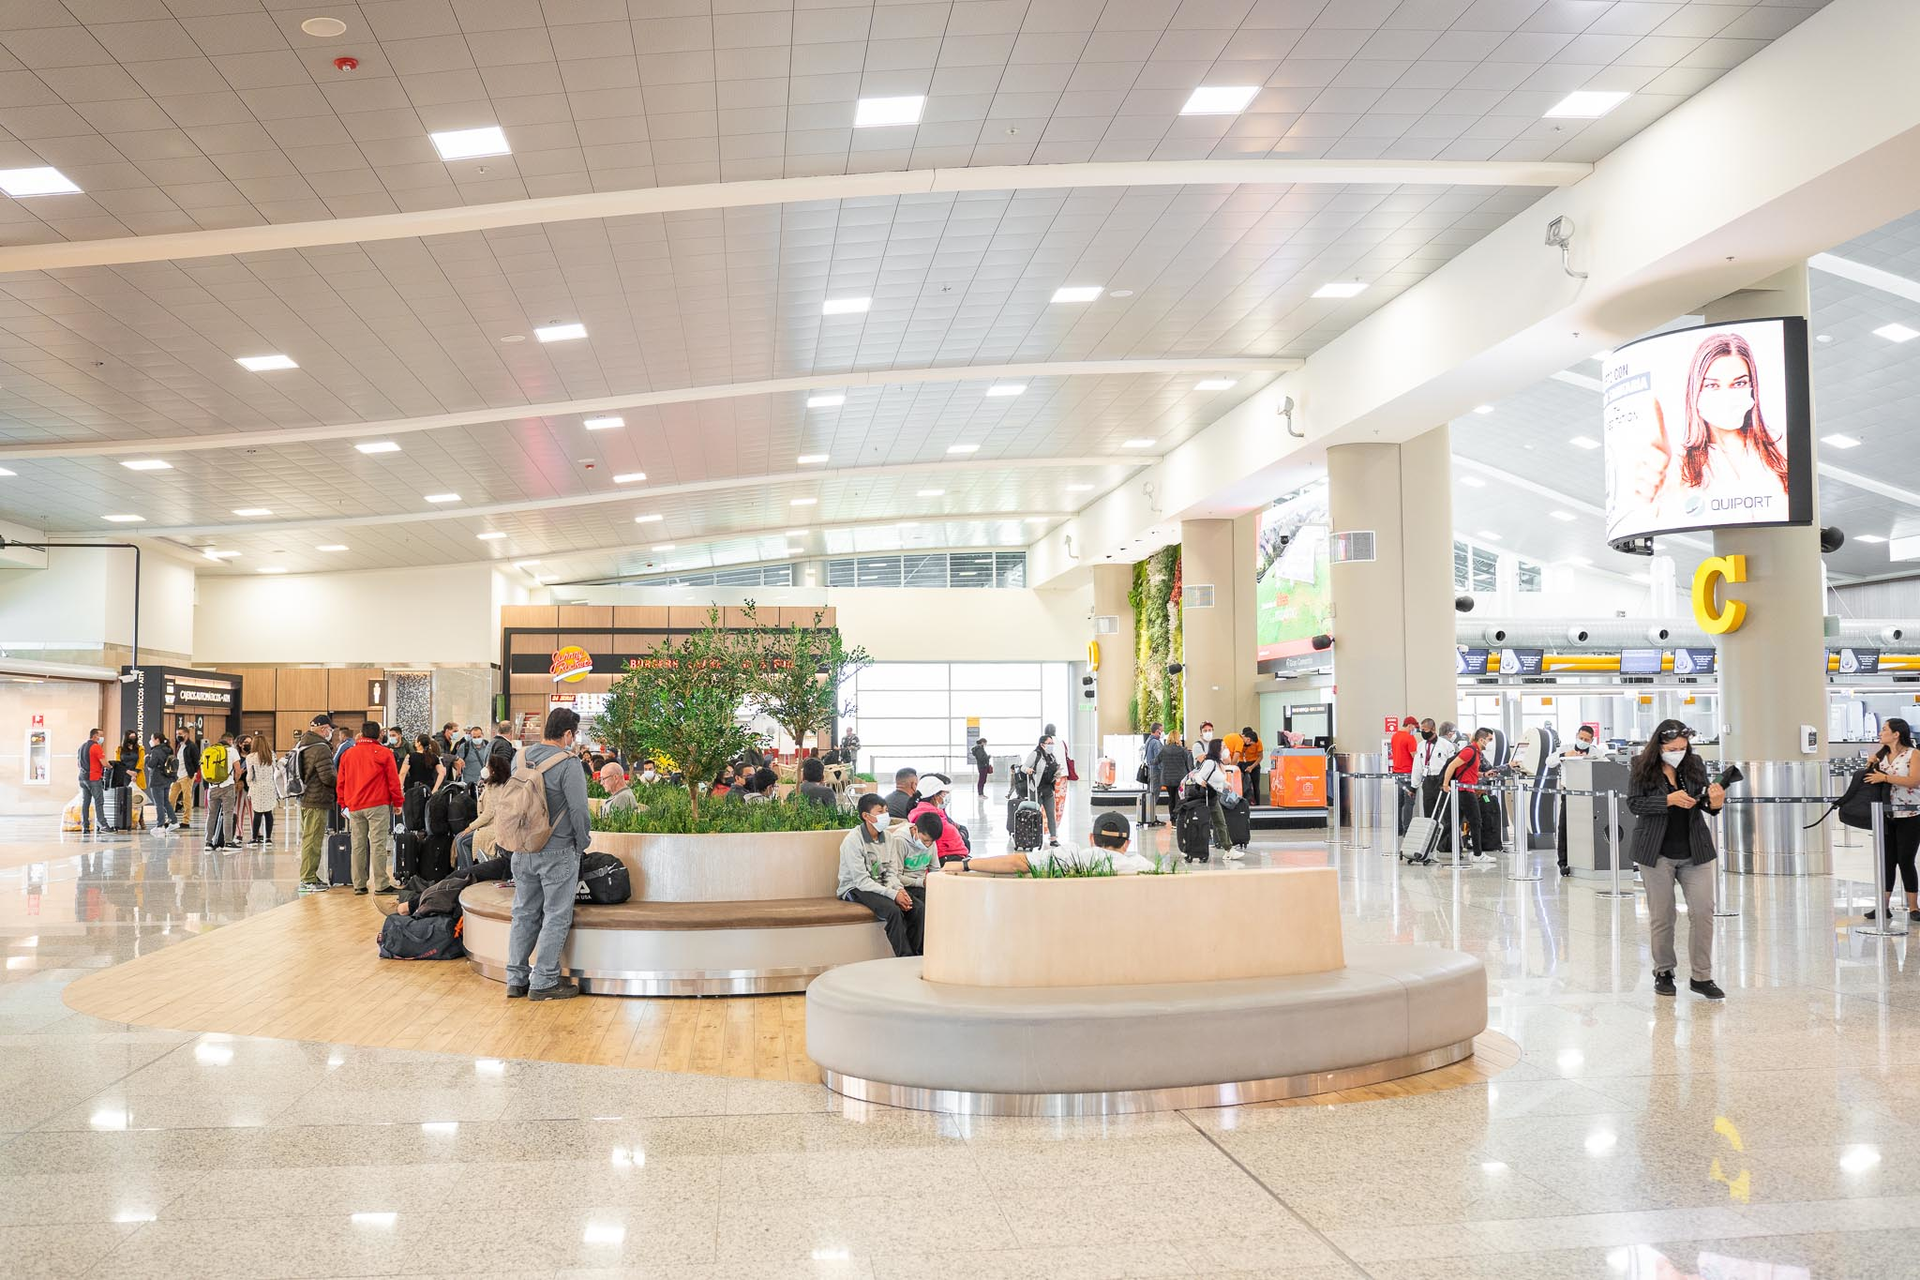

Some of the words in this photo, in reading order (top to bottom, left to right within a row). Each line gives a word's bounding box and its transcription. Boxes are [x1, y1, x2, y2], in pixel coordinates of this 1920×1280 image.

[1711, 496, 1773, 510] QUIPORT
[1691, 554, 1747, 634] C
[552, 649, 584, 663] Johnny
[550, 658, 593, 674] Rockets
